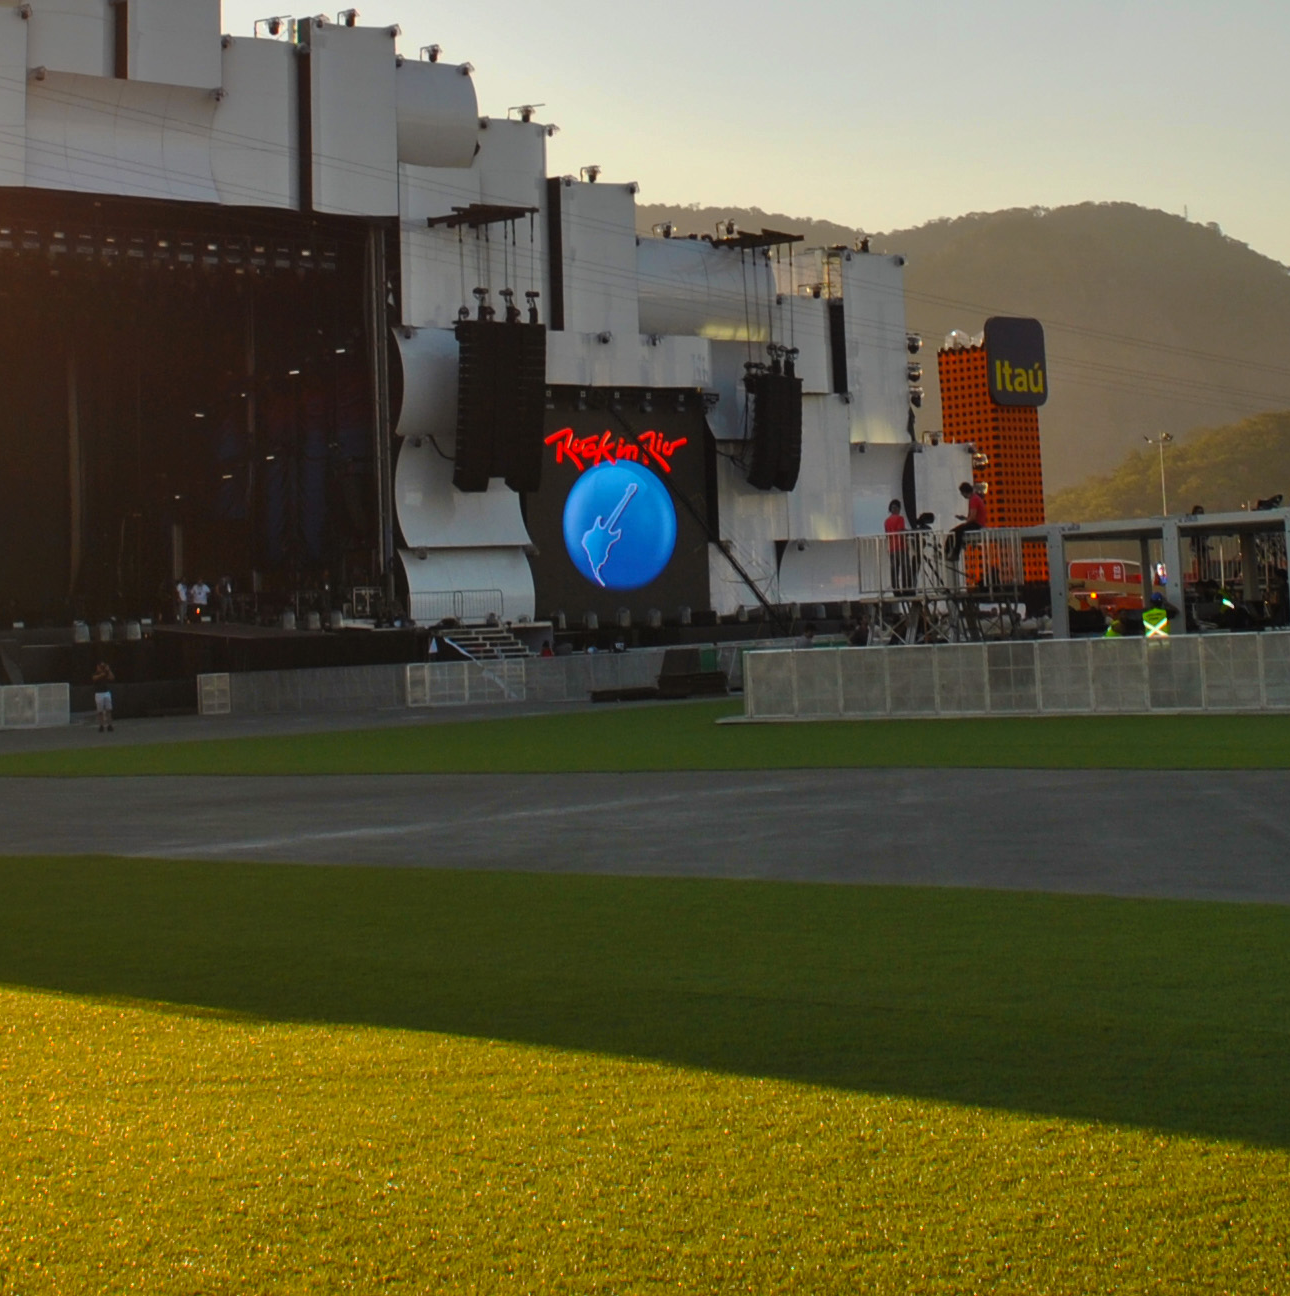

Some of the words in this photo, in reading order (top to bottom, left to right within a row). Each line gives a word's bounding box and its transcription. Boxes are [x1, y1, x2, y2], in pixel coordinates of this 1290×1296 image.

[995, 359, 1044, 393] Itaú
[544, 427, 616, 471] Rock
[616, 437, 639, 461] in
[638, 430, 688, 472] Rio
